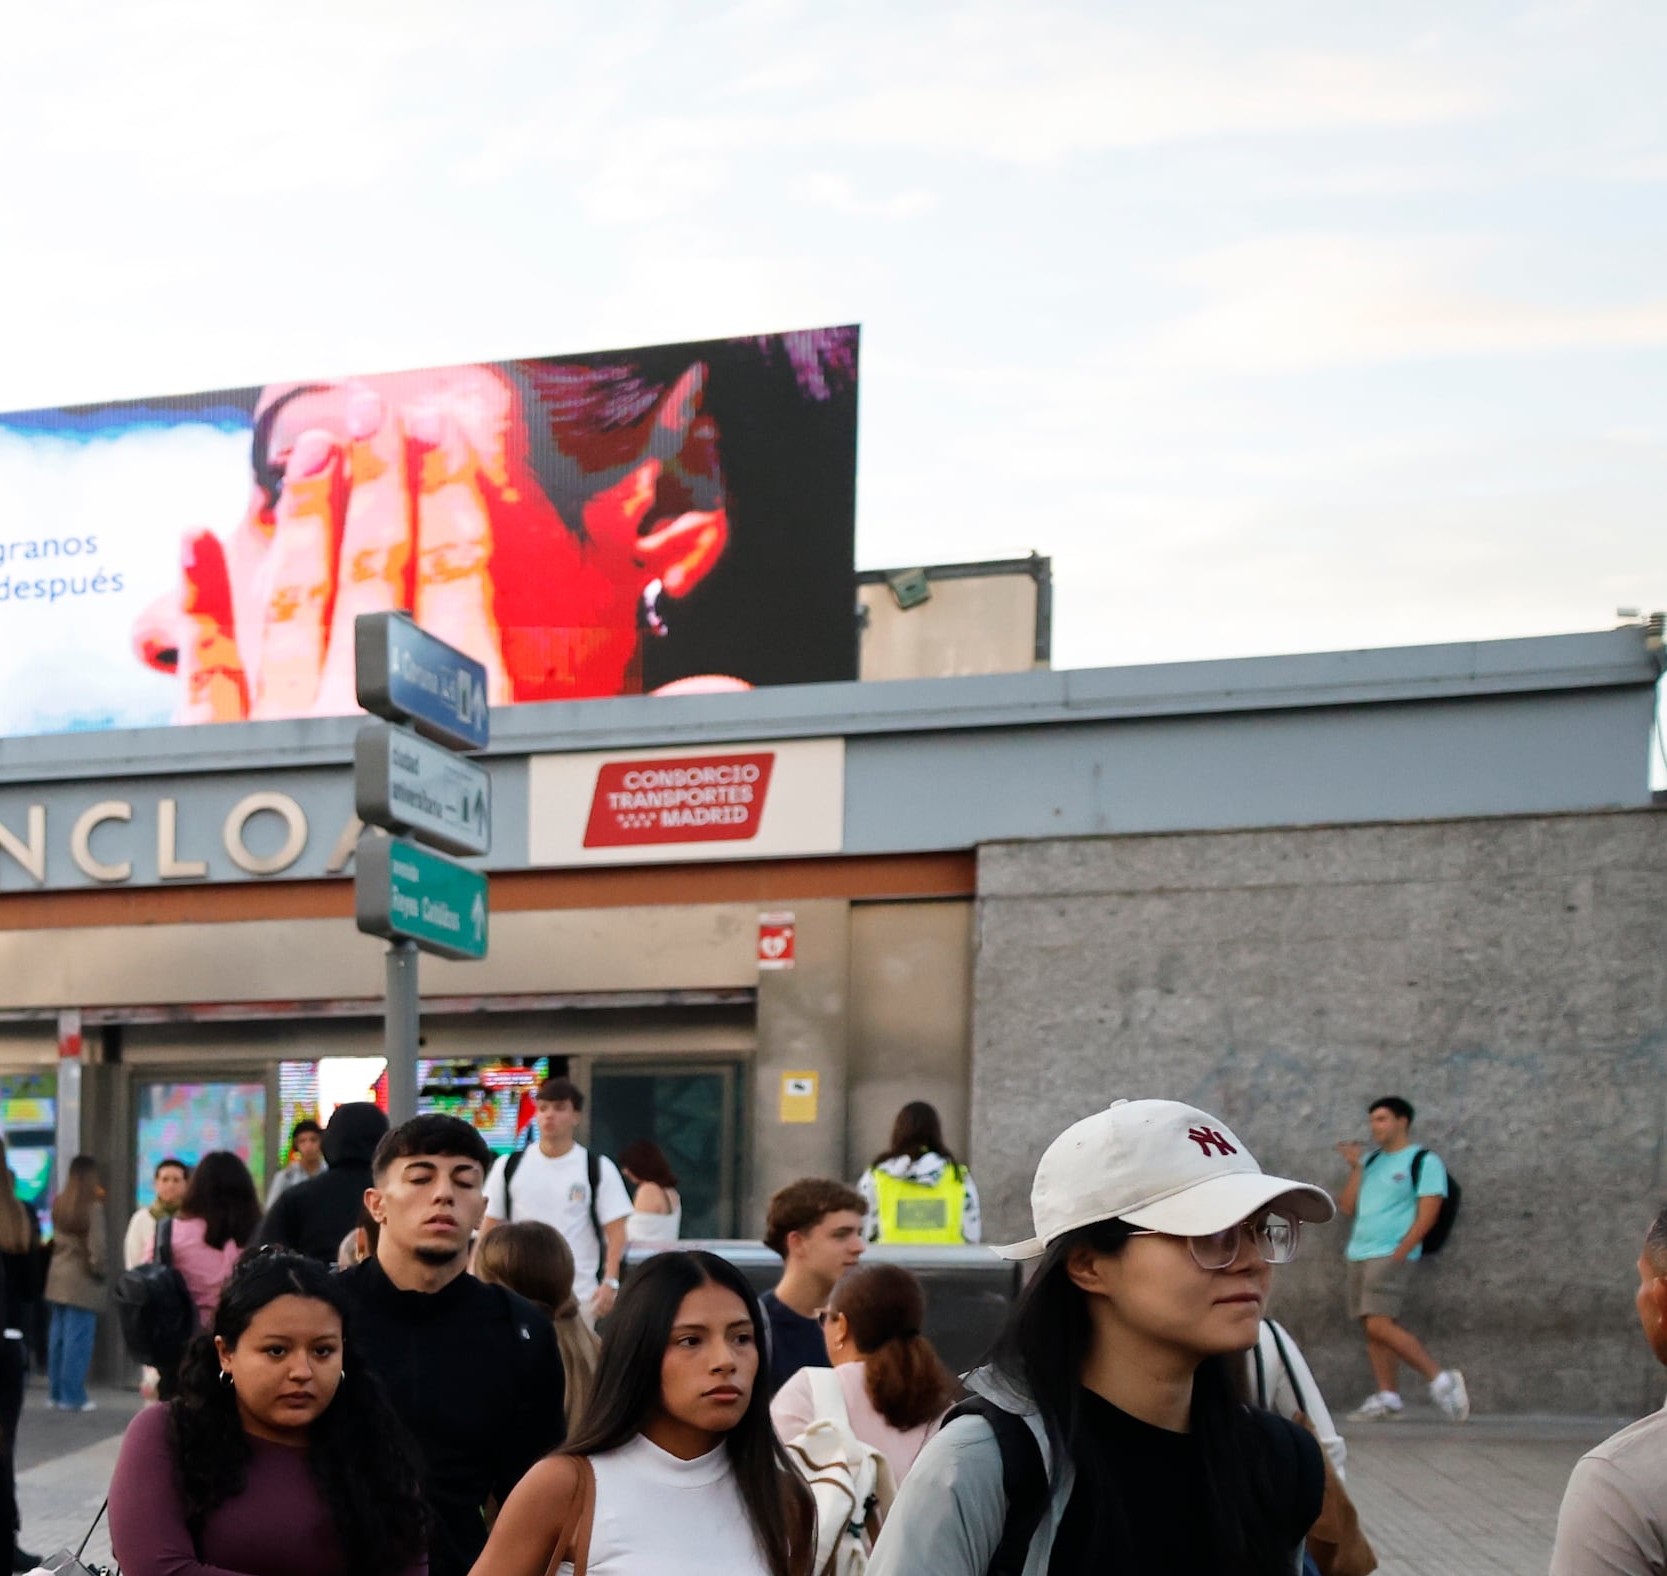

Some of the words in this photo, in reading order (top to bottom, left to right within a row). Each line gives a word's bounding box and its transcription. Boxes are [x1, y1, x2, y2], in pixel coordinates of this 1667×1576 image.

[623, 763, 761, 790] CONSORCIO
[608, 784, 754, 810] TRANSPORTES
[661, 805, 749, 828] MADRID
